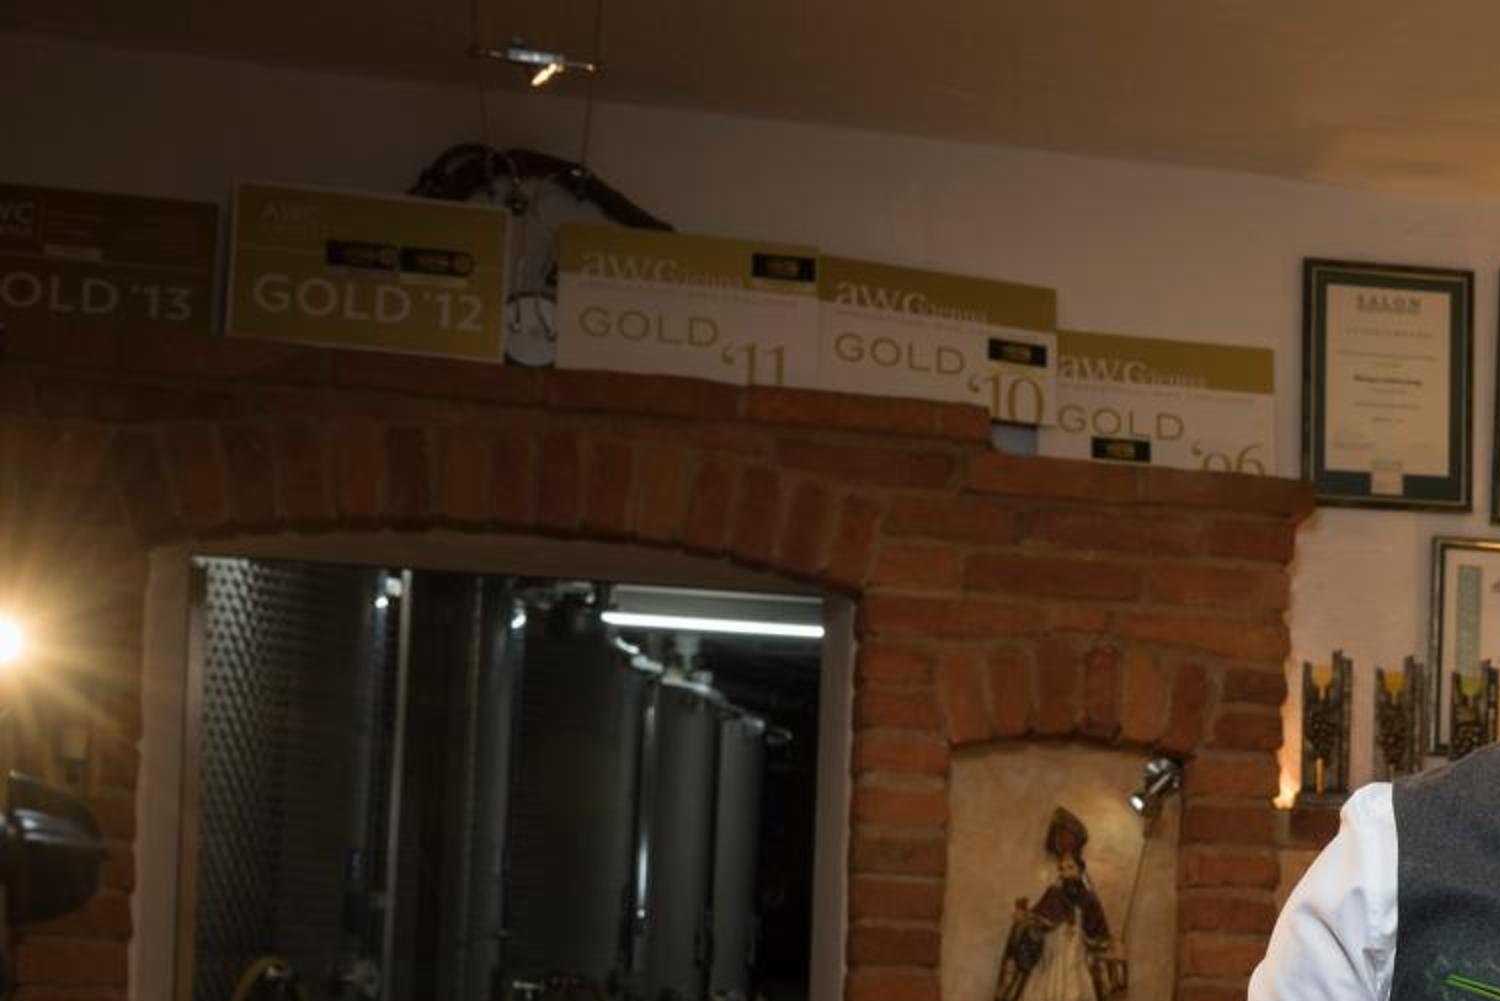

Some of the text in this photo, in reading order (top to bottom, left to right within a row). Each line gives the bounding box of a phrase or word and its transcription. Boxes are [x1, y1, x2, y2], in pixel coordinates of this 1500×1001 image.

[252, 272, 484, 333] GOLD '12
[836, 279, 928, 316] awc
[578, 305, 720, 348] GOLD
[833, 332, 966, 376] GOLD
[1058, 352, 1146, 384] awc
[1057, 404, 1185, 441] GOLD
